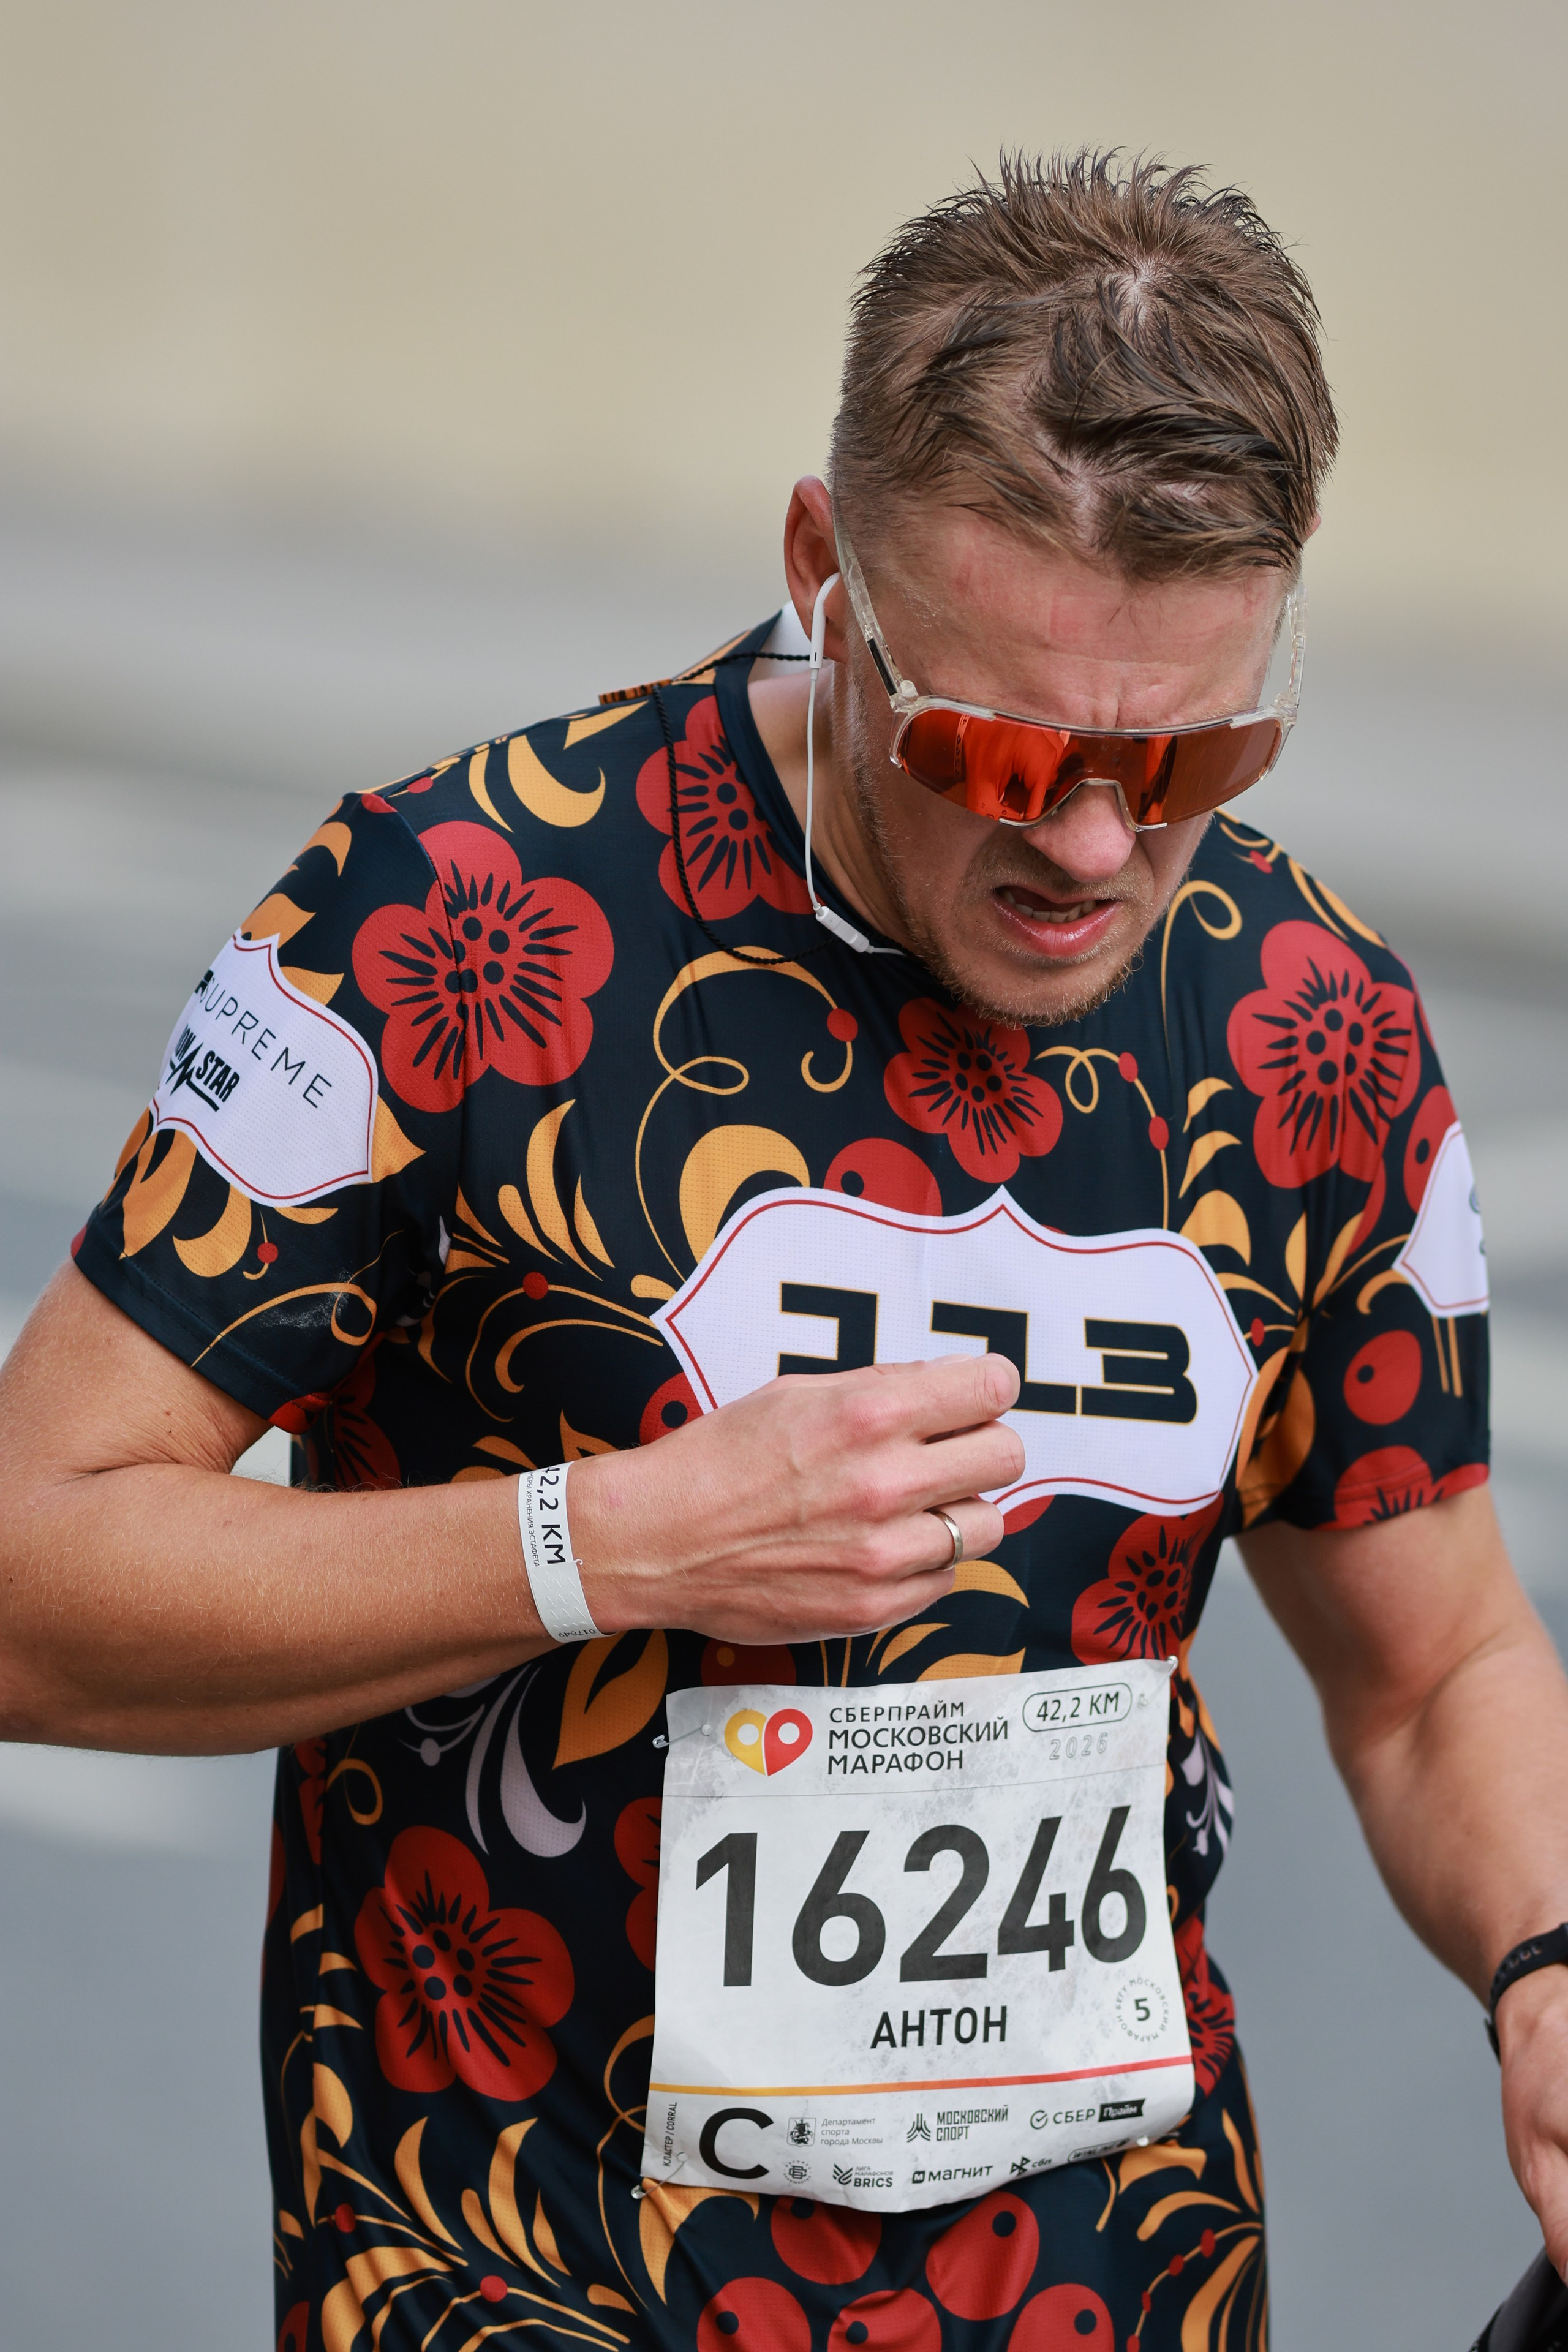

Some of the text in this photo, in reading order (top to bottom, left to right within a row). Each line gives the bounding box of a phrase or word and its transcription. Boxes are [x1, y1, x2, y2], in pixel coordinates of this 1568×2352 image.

[199, 977, 332, 1108] SUPREME
[195, 1050, 240, 1103] STAR
[537, 1467, 560, 1511] 42,2
[829, 1700, 965, 1723] СБЕРПРАЙМ
[1036, 1697, 1082, 1723] 42,2
[829, 1716, 1009, 1749] МОСКОВСКИЙ
[1049, 1732, 1109, 1760] 2026
[827, 1750, 963, 1775] МАРАФОН
[695, 1804, 1147, 1987] 16246
[1134, 1997, 1150, 2021] 5
[870, 2005, 1008, 2049] АНТОН
[666, 2102, 677, 2130] CORRAL
[821, 2118, 876, 2127] Департамент
[937, 2105, 1008, 2125] МОСКОВСКИЙ
[1054, 2109, 1095, 2124] СБЕР
[1103, 2103, 1138, 2119] Прайм
[936, 2126, 970, 2141] СПОРТ
[663, 2135, 673, 2166] КЛАСТЕР
[854, 2177, 893, 2187] BRICS
